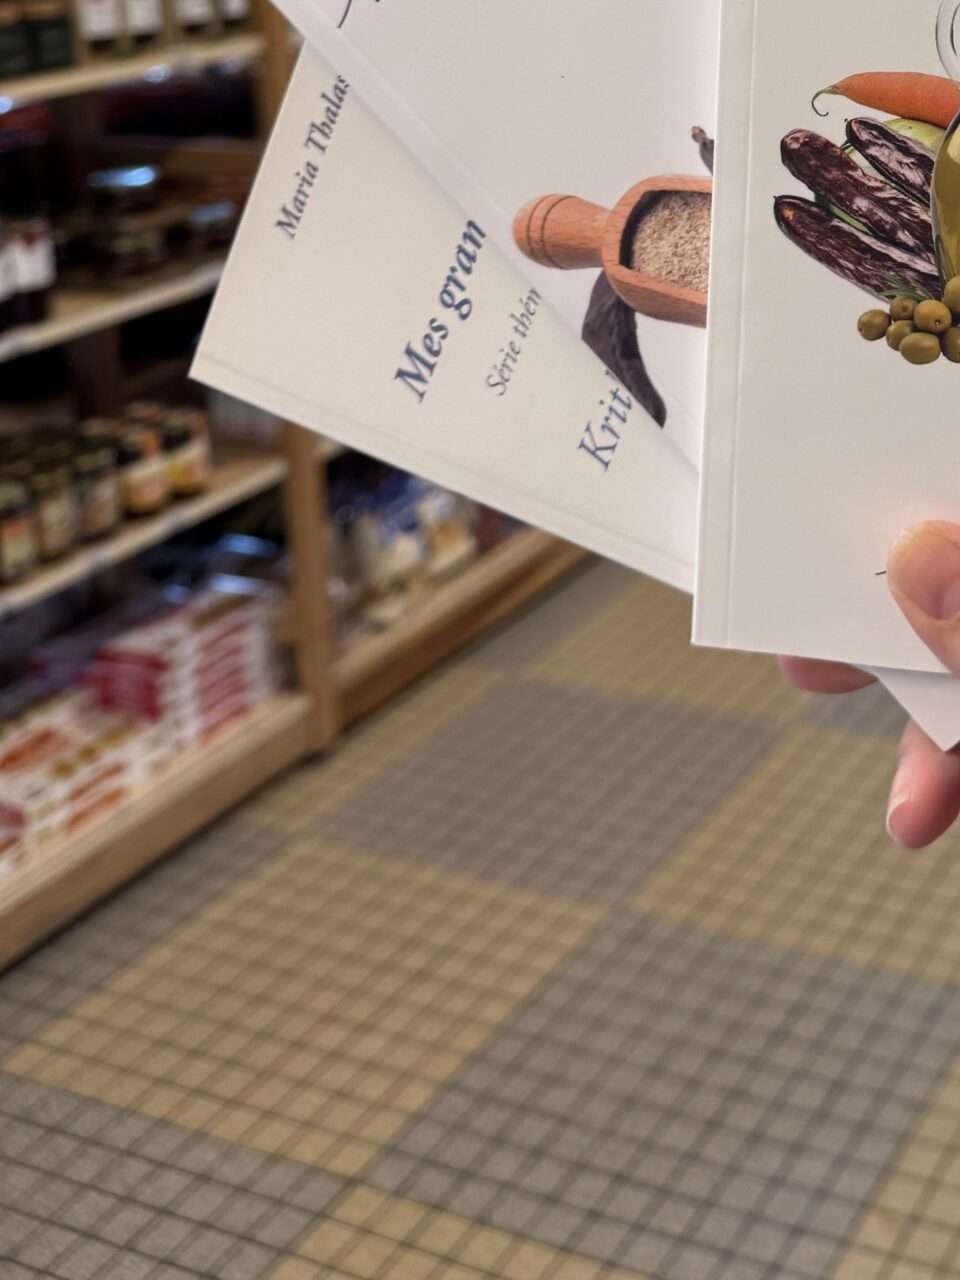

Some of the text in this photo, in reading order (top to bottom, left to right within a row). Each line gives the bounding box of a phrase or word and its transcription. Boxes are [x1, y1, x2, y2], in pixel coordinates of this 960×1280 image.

[275, 160, 320, 241] Maria
[393, 219, 487, 405] Mes gran
[485, 339, 522, 398] Série
